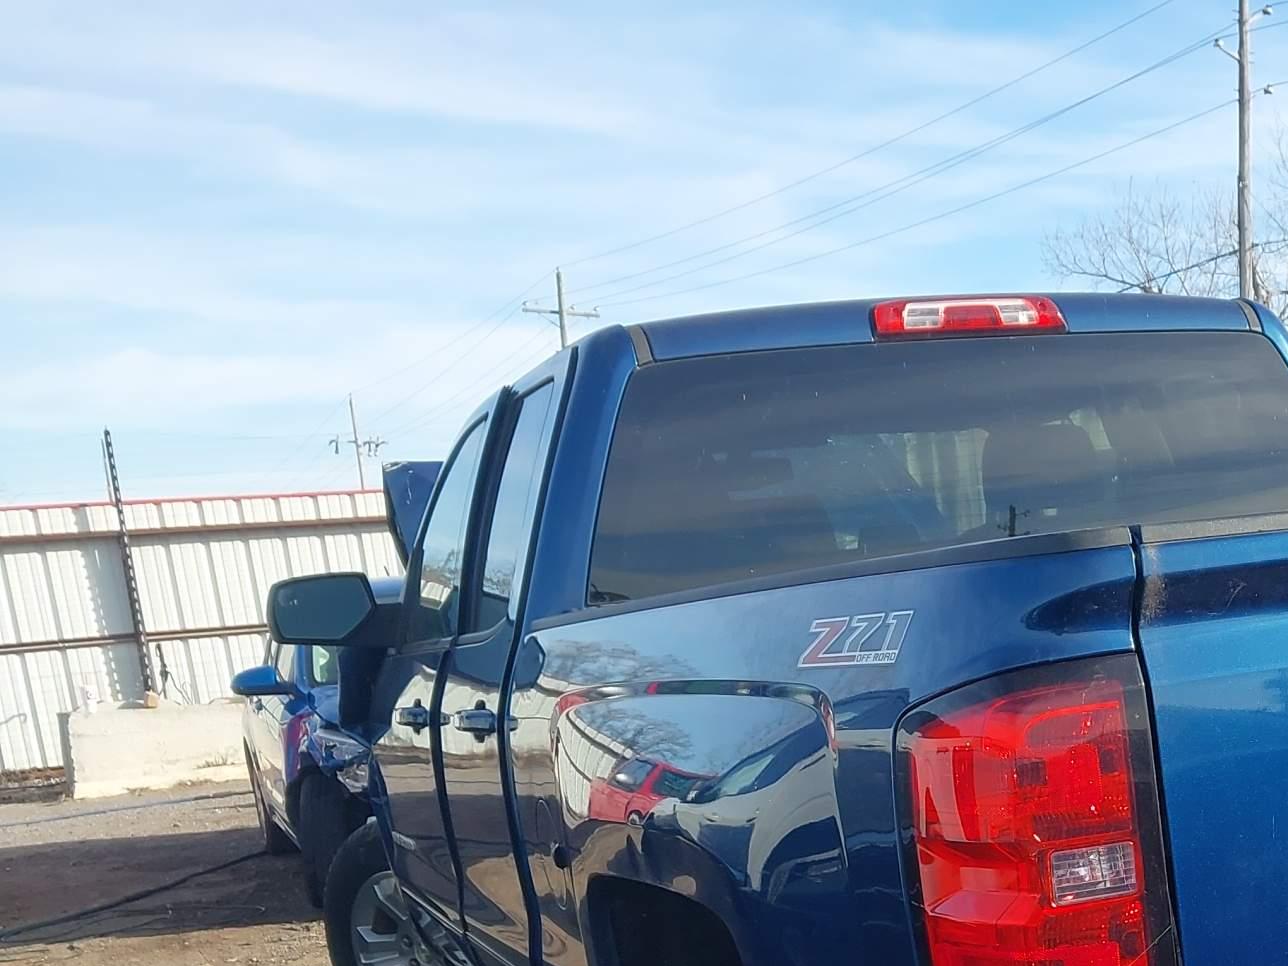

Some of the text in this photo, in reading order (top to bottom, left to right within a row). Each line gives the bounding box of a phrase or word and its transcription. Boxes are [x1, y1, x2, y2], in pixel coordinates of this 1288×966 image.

[798, 610, 914, 667] Z71
[856, 651, 896, 662] OFF ROAD
